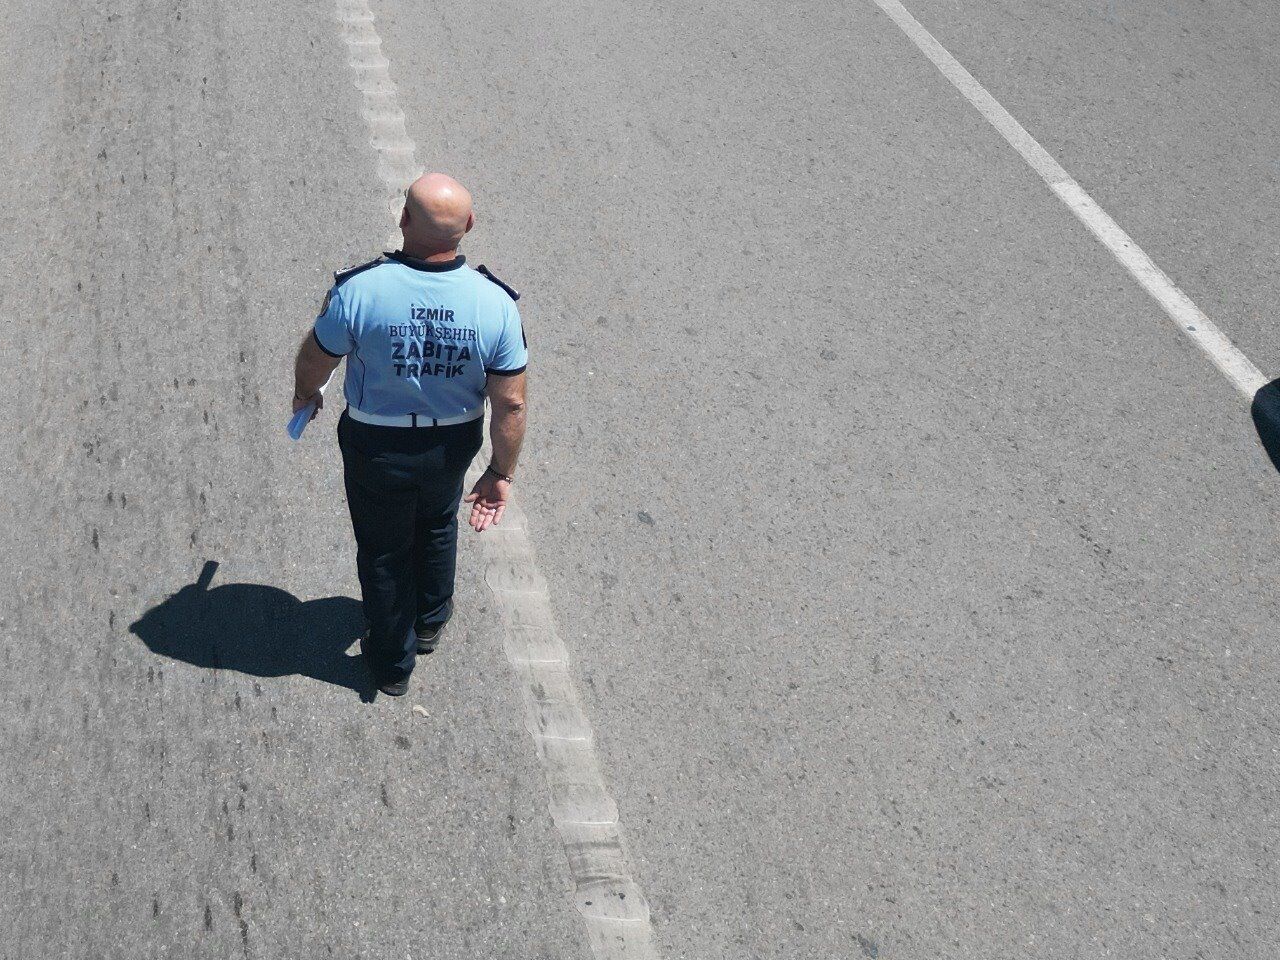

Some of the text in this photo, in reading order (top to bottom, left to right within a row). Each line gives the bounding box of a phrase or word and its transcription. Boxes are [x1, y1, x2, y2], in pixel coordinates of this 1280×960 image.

[410, 303, 455, 322] İZMİR
[389, 322, 477, 342] BÜYÜKŞEHİR
[391, 340, 472, 362] ZABITA
[393, 362, 466, 379] TRAFİK
